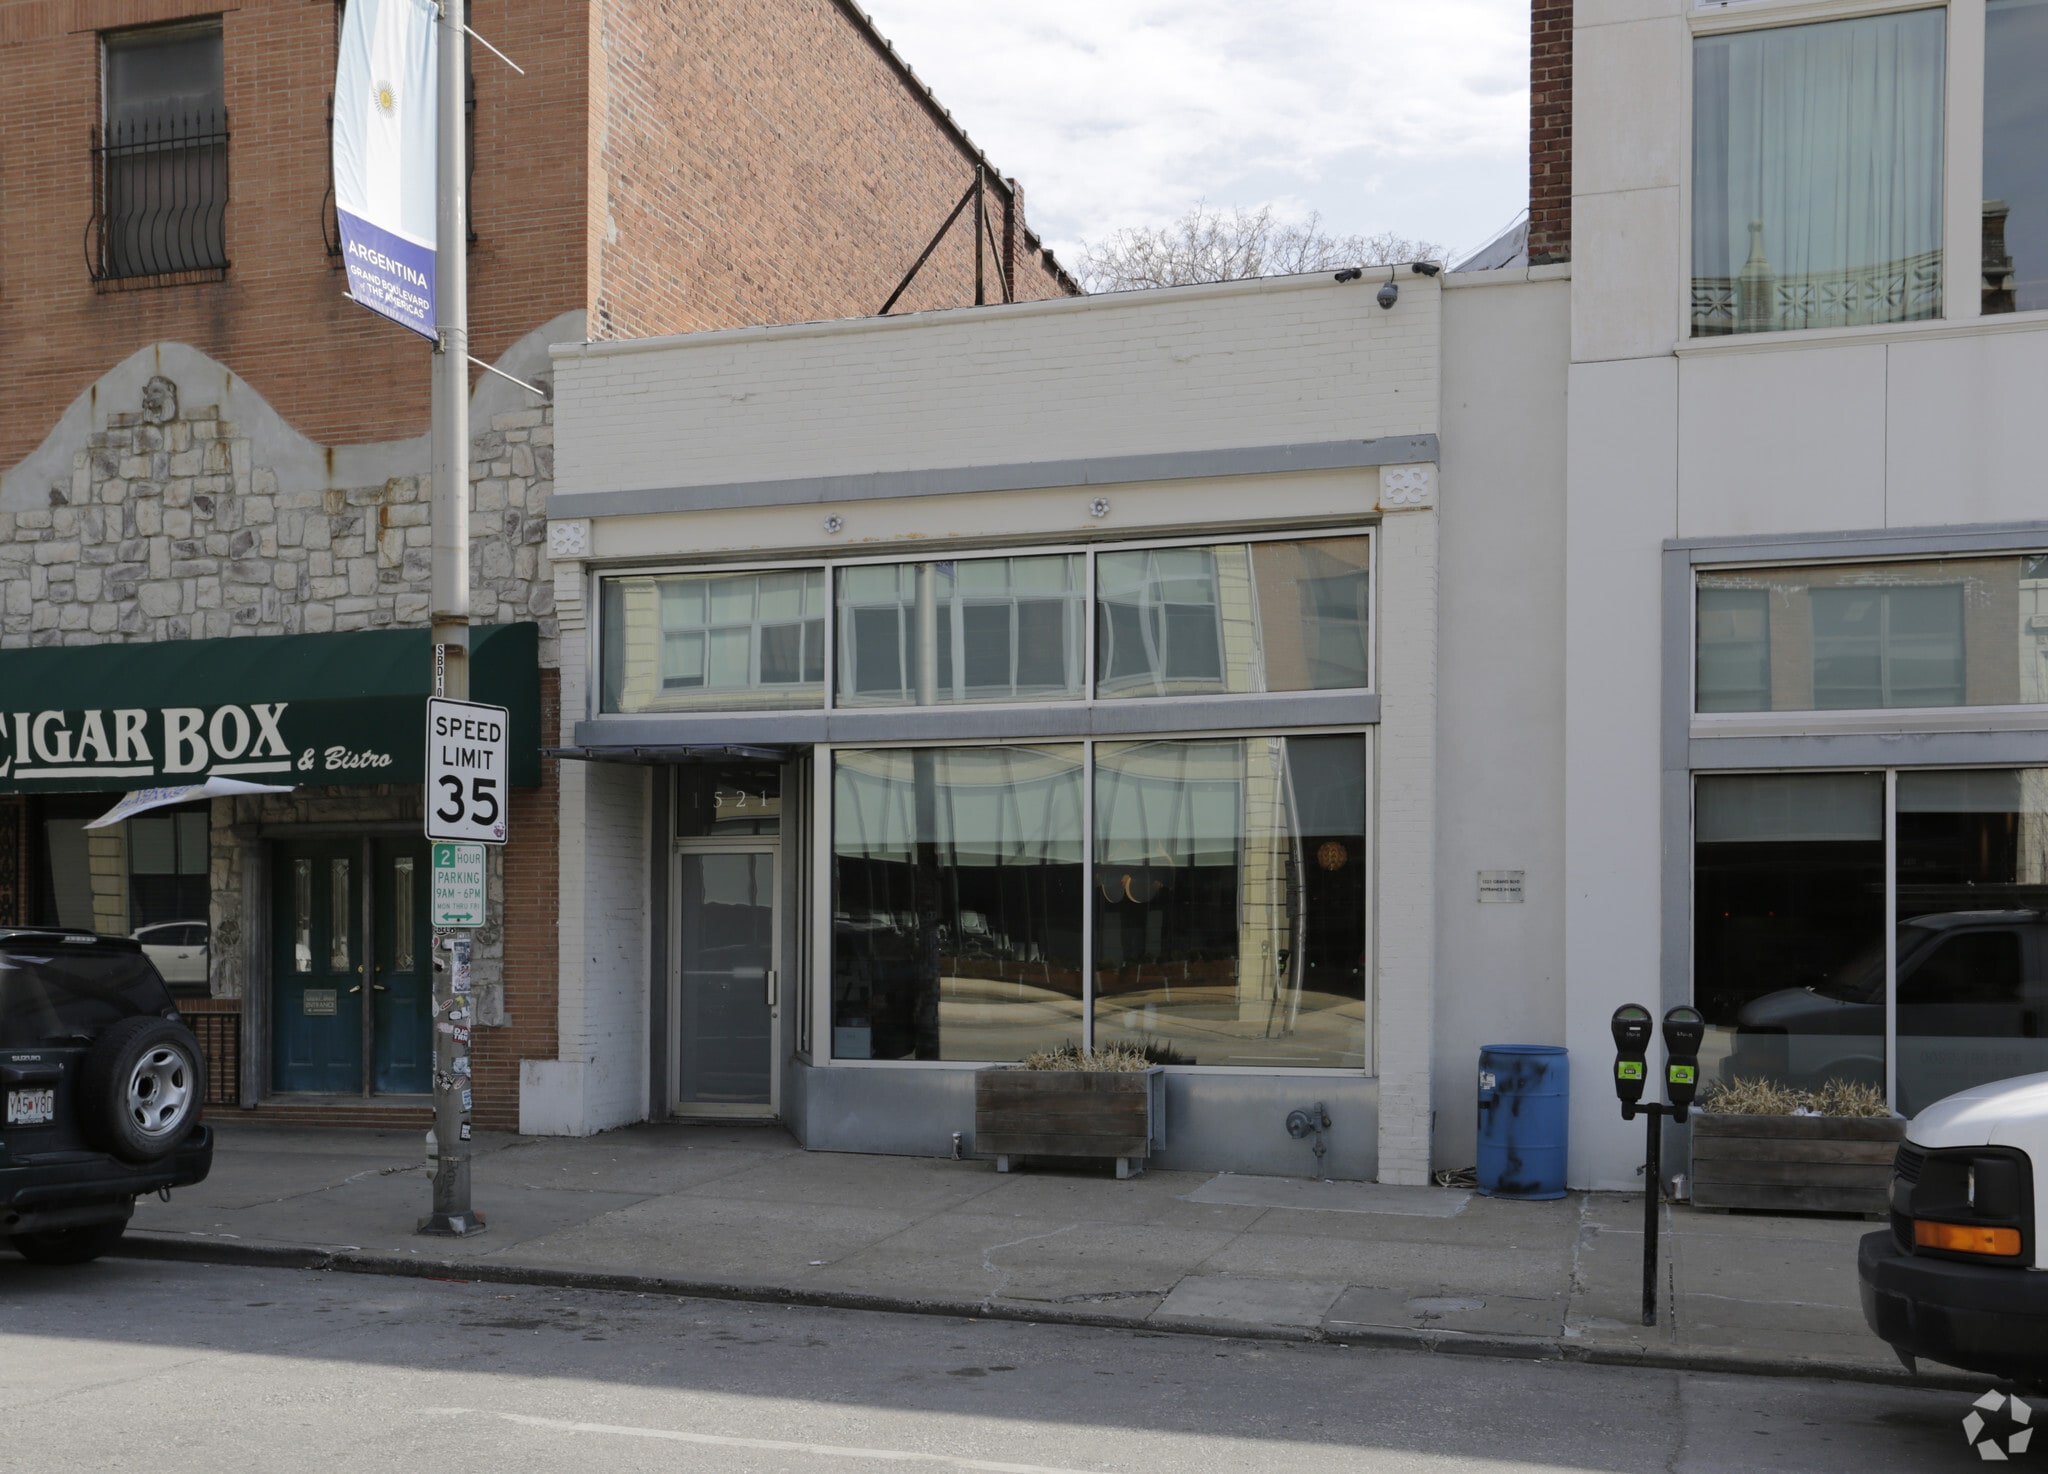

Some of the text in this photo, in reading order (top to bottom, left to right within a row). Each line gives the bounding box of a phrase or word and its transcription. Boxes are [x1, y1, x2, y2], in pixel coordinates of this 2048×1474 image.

[349, 240, 428, 290] ARGENTINA
[350, 265, 430, 310] GRAND BOULEVARD
[367, 283, 384, 298] THE
[384, 293, 424, 319] AMERICAS
[161, 702, 291, 774] BOX
[297, 747, 315, 771] &
[324, 745, 392, 771] Bistro
[436, 715, 500, 743] SPEED
[442, 745, 493, 770] LIMIT
[436, 774, 499, 827] 35
[441, 849, 481, 866] 2 HOUR
[436, 888, 455, 898] 9AM
[463, 888, 481, 899] 6PM
[437, 871, 480, 884] PARKING
